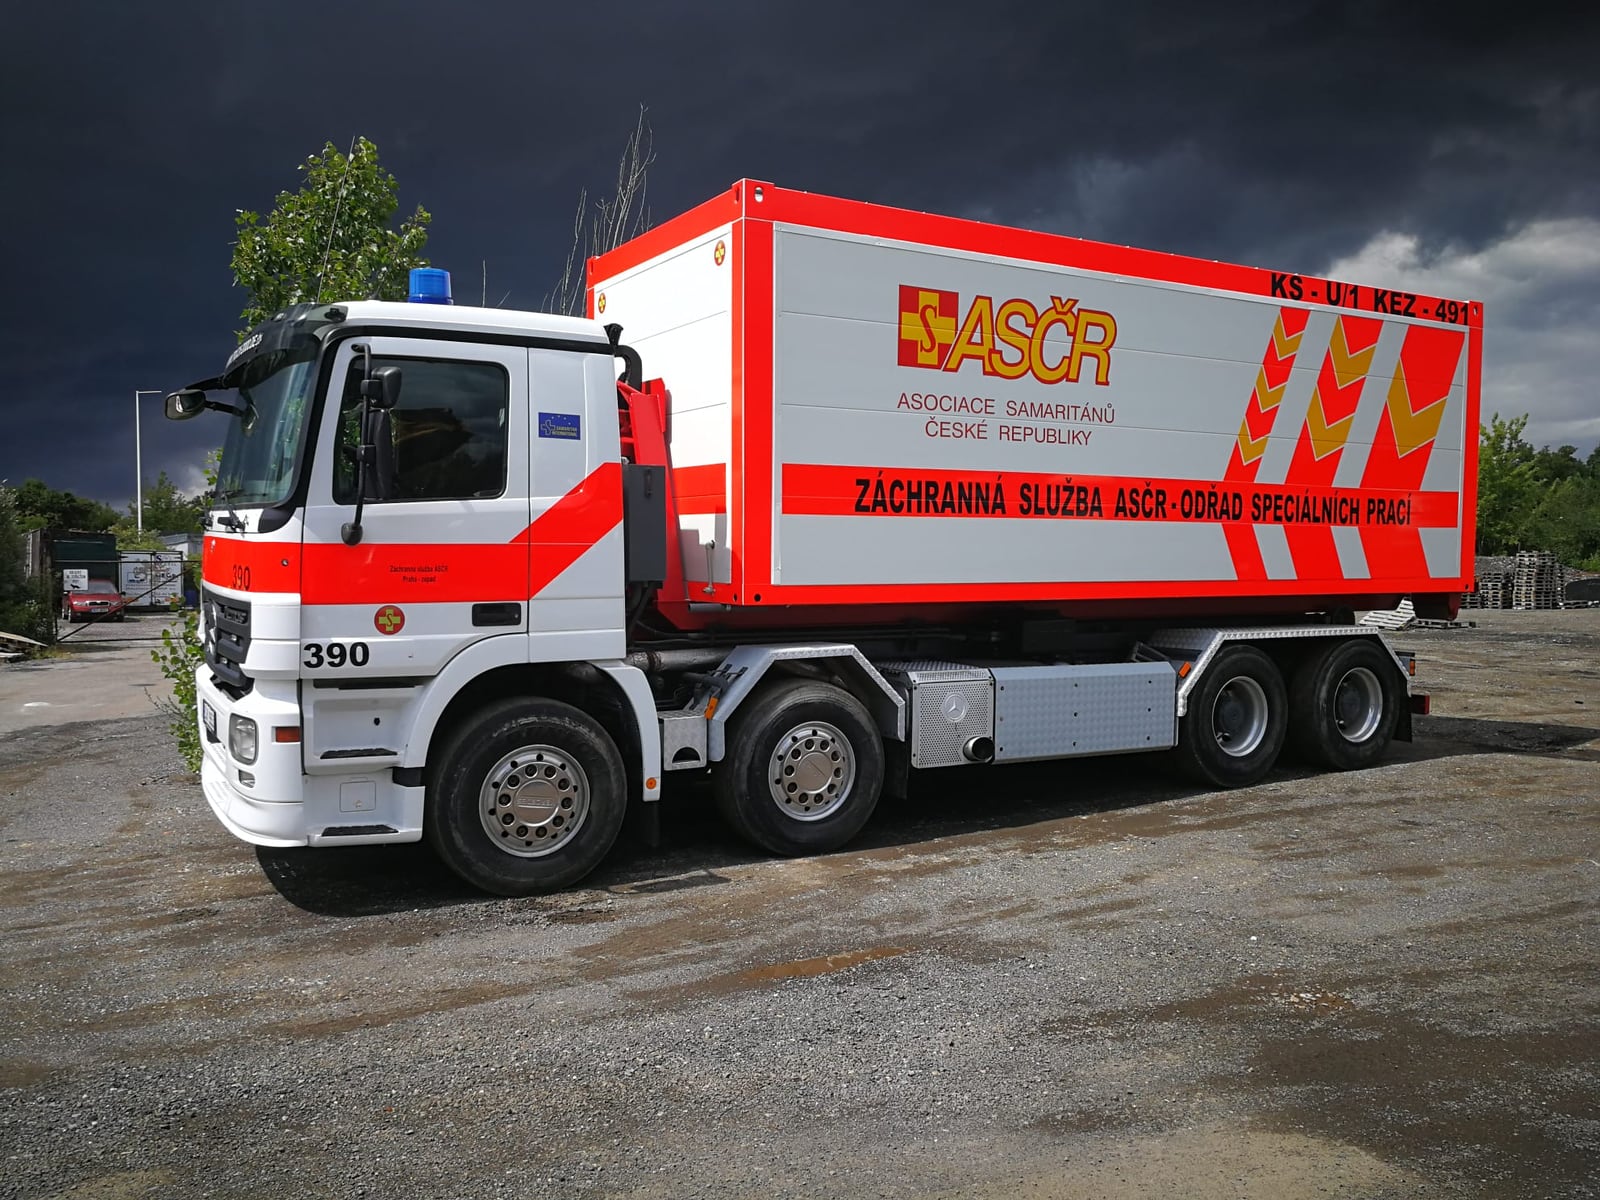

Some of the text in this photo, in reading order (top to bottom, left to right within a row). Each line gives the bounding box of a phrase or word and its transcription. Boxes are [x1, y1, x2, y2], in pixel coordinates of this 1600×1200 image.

[1271, 272, 1303, 301] KS
[1326, 281, 1359, 310] U/1
[1374, 289, 1416, 318] KEZ
[1435, 300, 1469, 326] 491
[942, 295, 1118, 386] ASČR
[897, 392, 1116, 424] ASOCIACE SAMARITÁNŮ
[925, 416, 1092, 446] ČESKÉ REPUBLIKY
[854, 470, 1006, 515] ZÁCHRANNÁ
[1019, 477, 1103, 518] SLUŽBA
[1114, 481, 1167, 519] ASČR
[1180, 484, 1243, 521] ODŘAD
[1252, 488, 1360, 525] SPECIÁLNÍCH
[1366, 493, 1412, 526] PRACÍ
[232, 564, 251, 591] 390
[303, 641, 370, 669] 390
